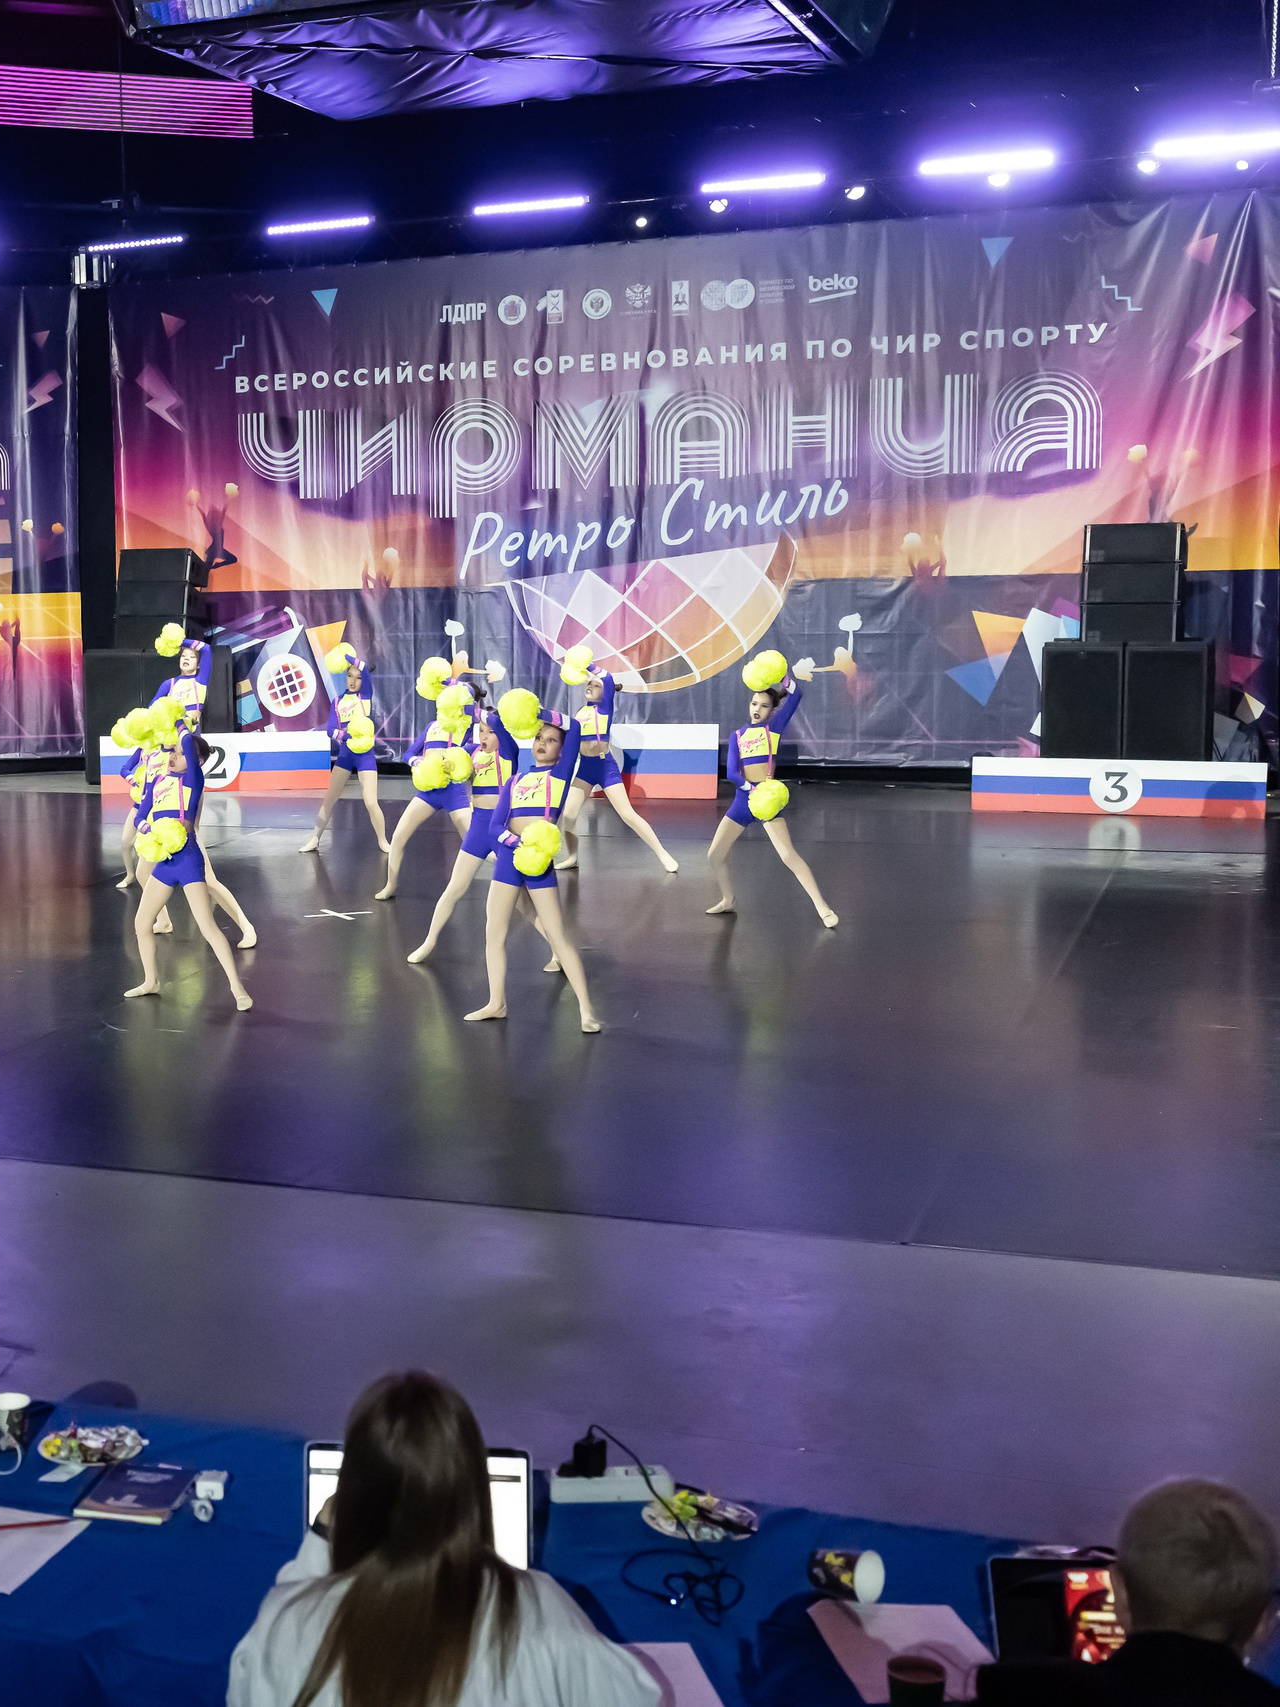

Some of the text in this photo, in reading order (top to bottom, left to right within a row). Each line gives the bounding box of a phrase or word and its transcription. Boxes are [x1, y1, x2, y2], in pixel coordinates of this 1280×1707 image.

[808, 274, 858, 291] beko
[439, 302, 487, 325] ЛДПР
[235, 322, 1108, 394] ВСЕРОССИЙСКИЕ СОРЕВНОВАНИЯ ПО ЧИР СПОРТУ
[459, 477, 850, 580] Ретро Стиль
[204, 745, 227, 779] 2
[1103, 771, 1130, 803] 3
